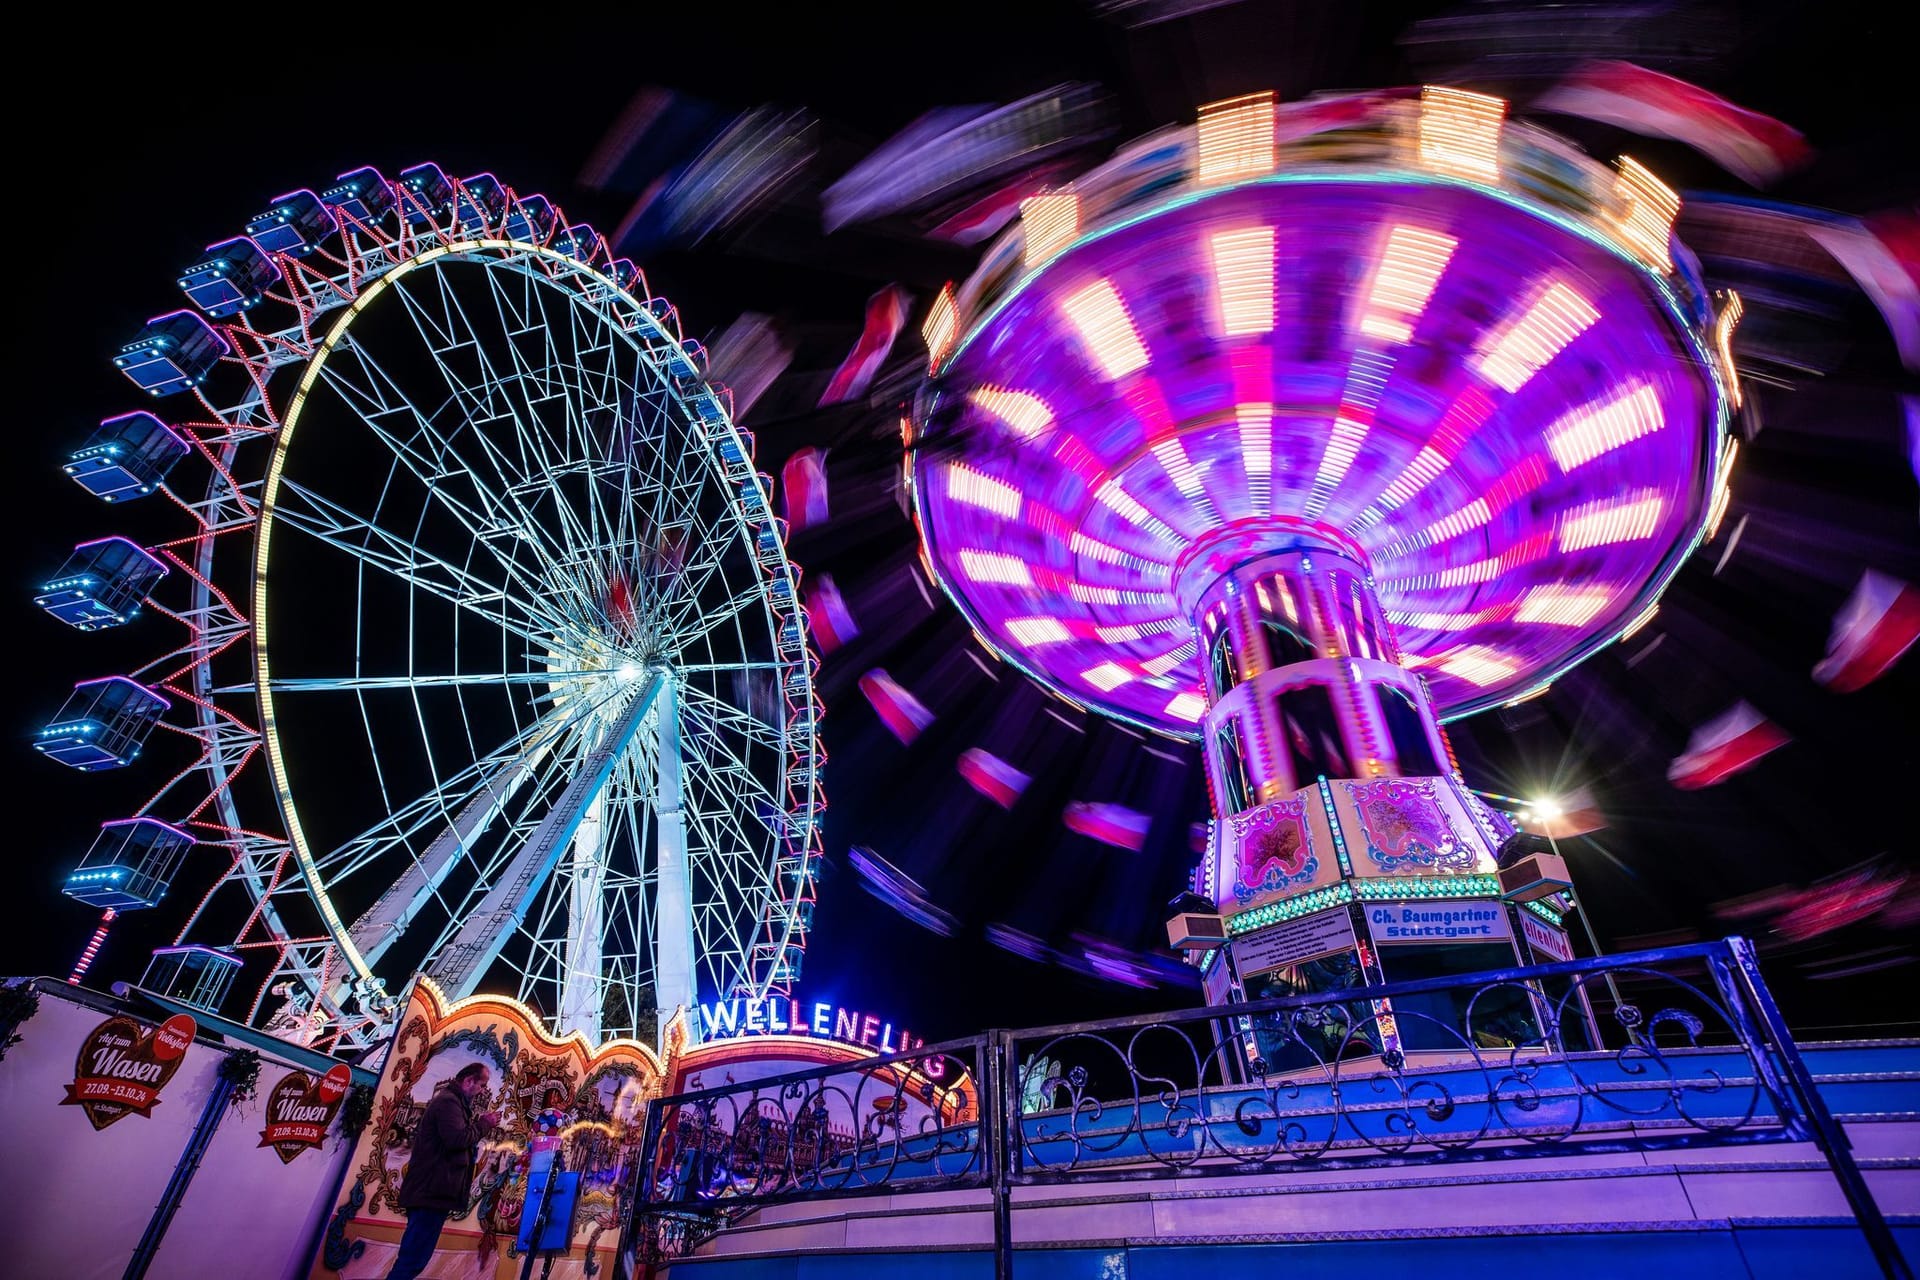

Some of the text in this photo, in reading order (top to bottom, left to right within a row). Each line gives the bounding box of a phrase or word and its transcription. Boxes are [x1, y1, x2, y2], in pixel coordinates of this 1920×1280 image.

[1372, 908, 1498, 926] Ch. Baumgartner
[1386, 924, 1492, 938] Stuttgart
[98, 1033, 132, 1048] Auf zum
[92, 1047, 163, 1082] Wasen
[276, 1098, 328, 1122] Wasen
